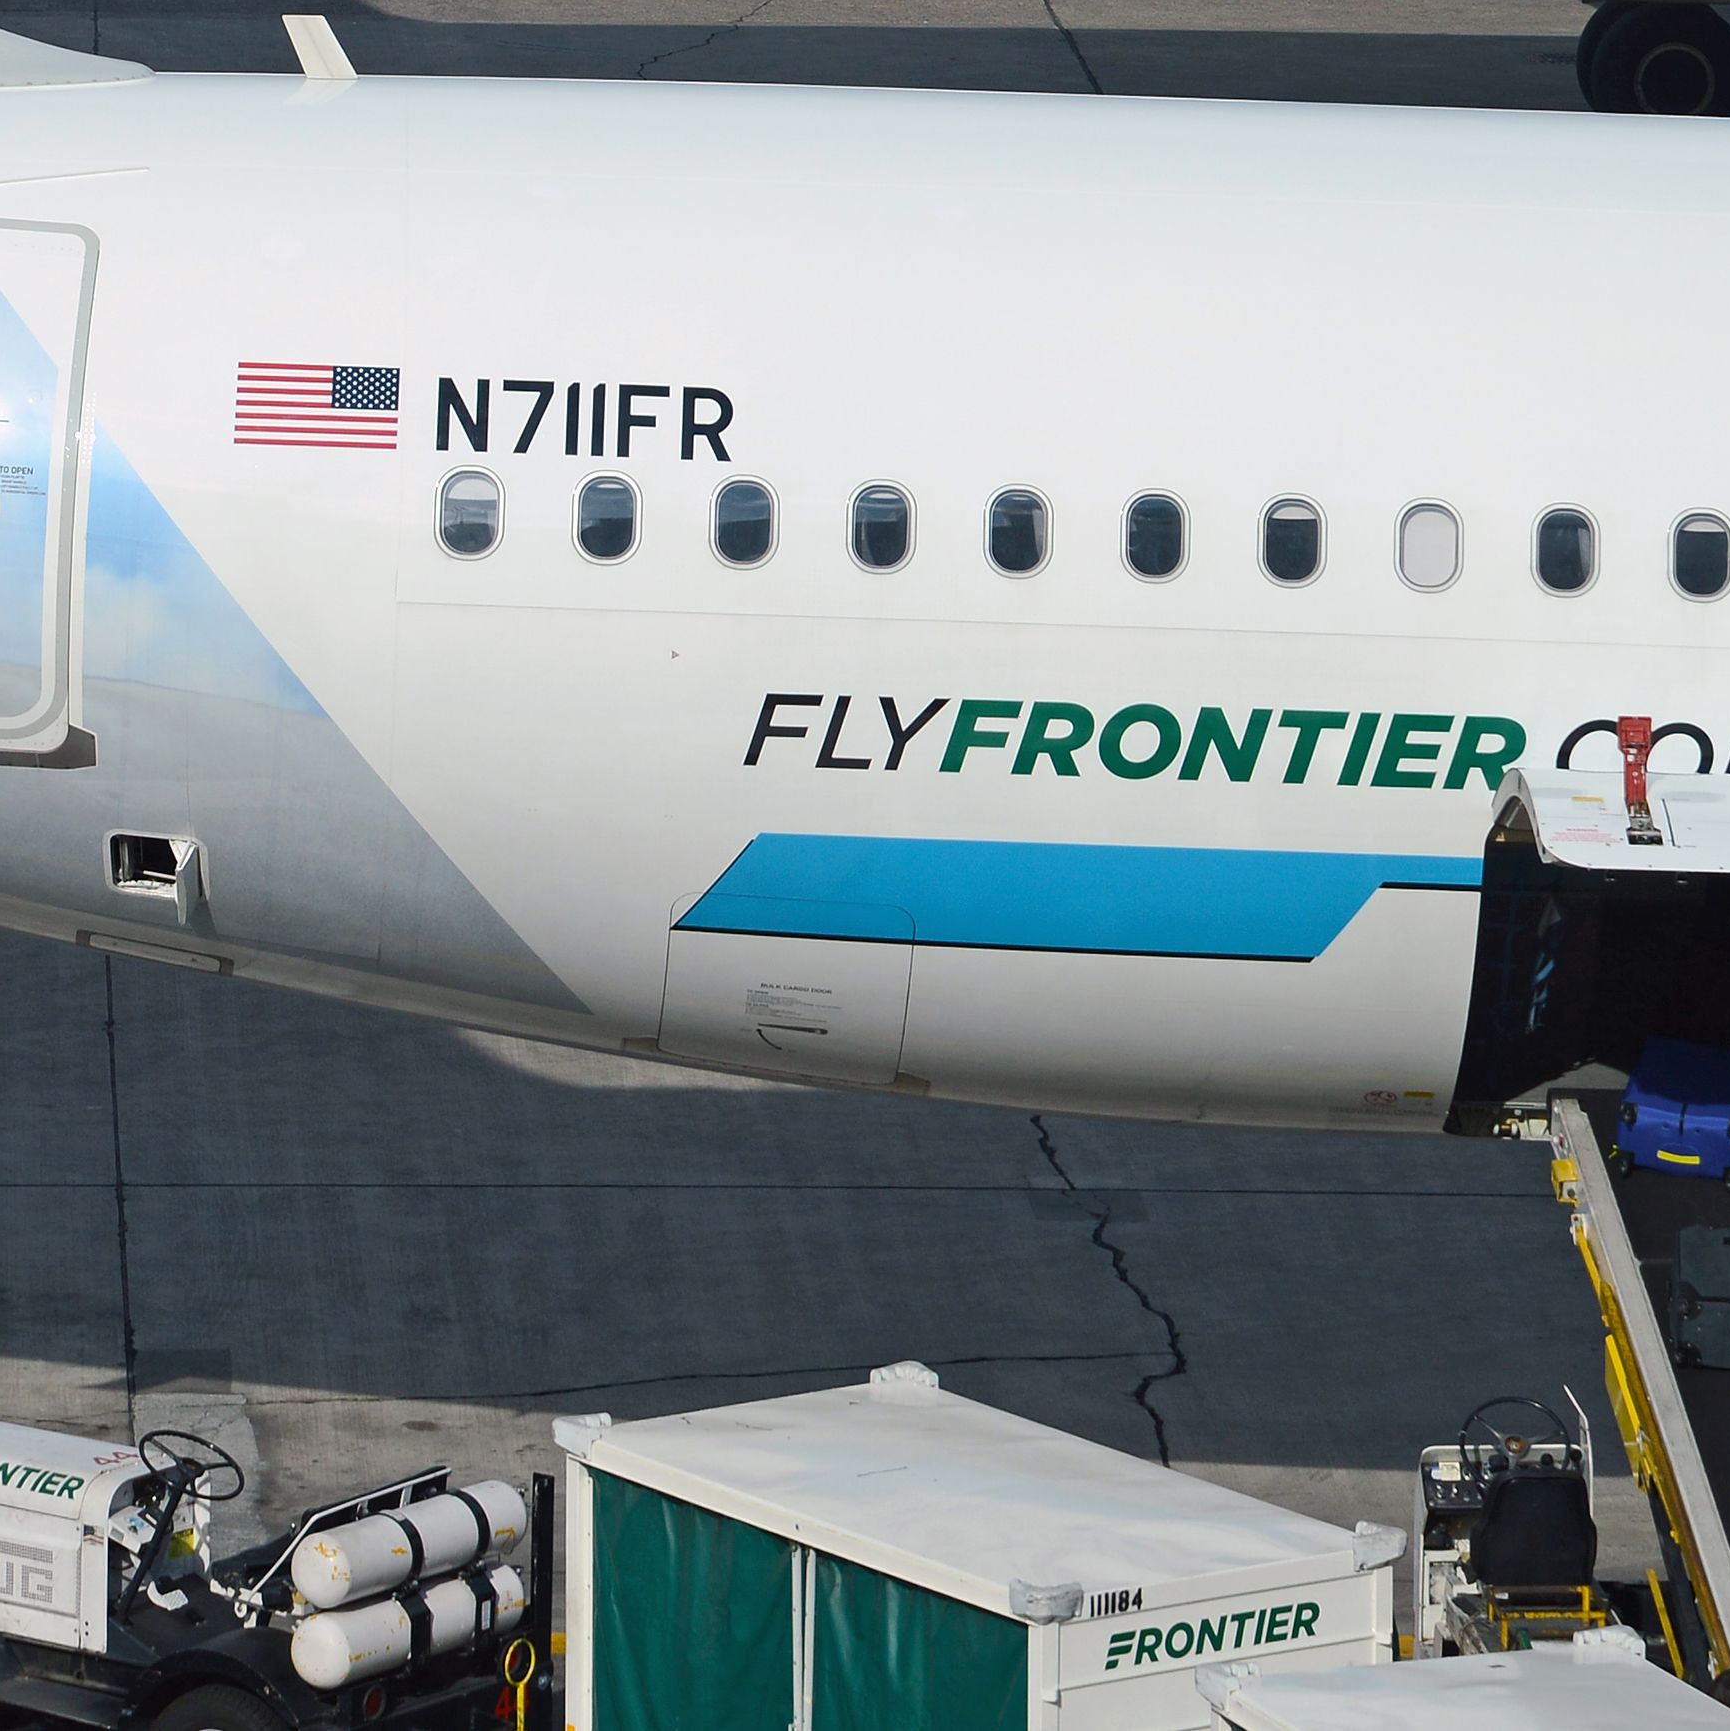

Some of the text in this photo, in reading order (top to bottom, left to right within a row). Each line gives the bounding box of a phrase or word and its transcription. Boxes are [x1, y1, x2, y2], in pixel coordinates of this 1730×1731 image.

[437, 377, 734, 462] N711FR
[11, 466, 33, 475] OPEN
[1090, 1587, 1143, 1617] 111184
[1105, 1602, 1321, 1670] FRONTIER
